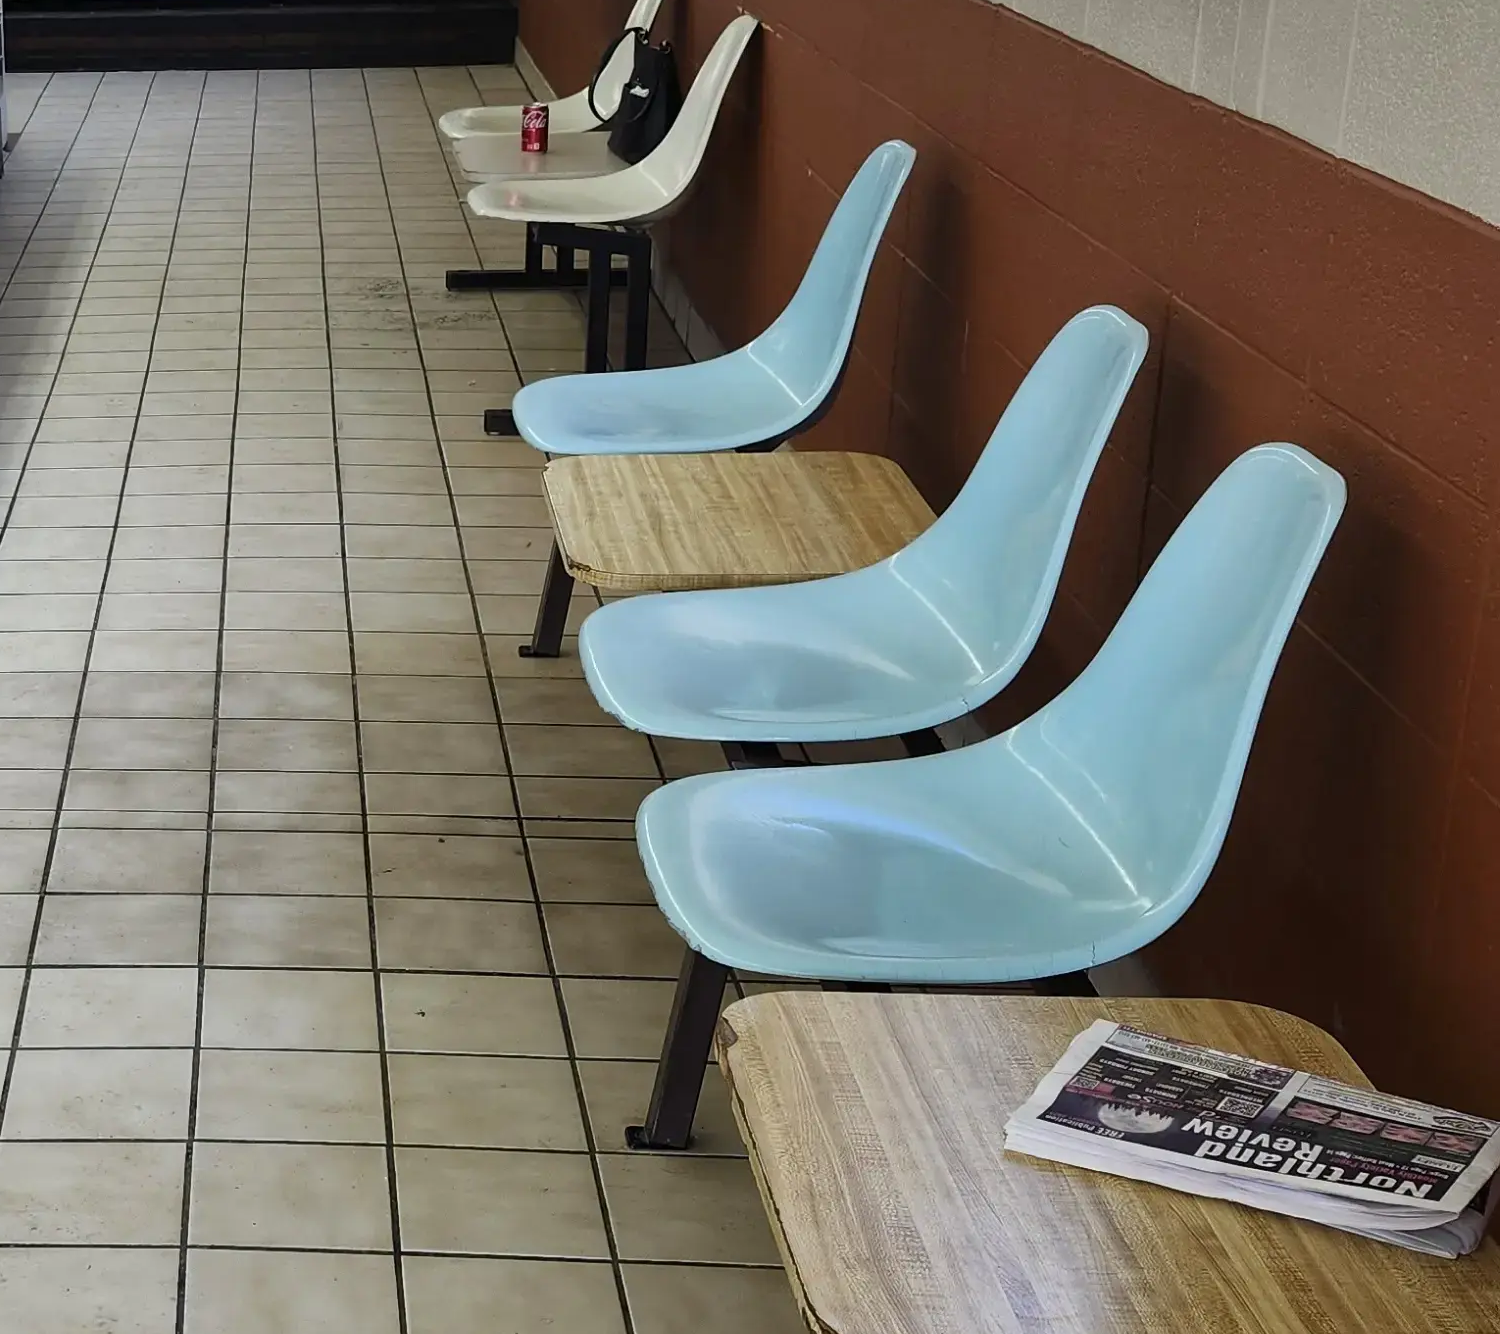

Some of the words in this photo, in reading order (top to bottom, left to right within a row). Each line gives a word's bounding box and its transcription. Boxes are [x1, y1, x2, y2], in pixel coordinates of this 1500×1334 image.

[1094, 1128, 1125, 1138] FREE
[1181, 1117, 1324, 1162] Review
[1194, 1140, 1434, 1199] Northland
